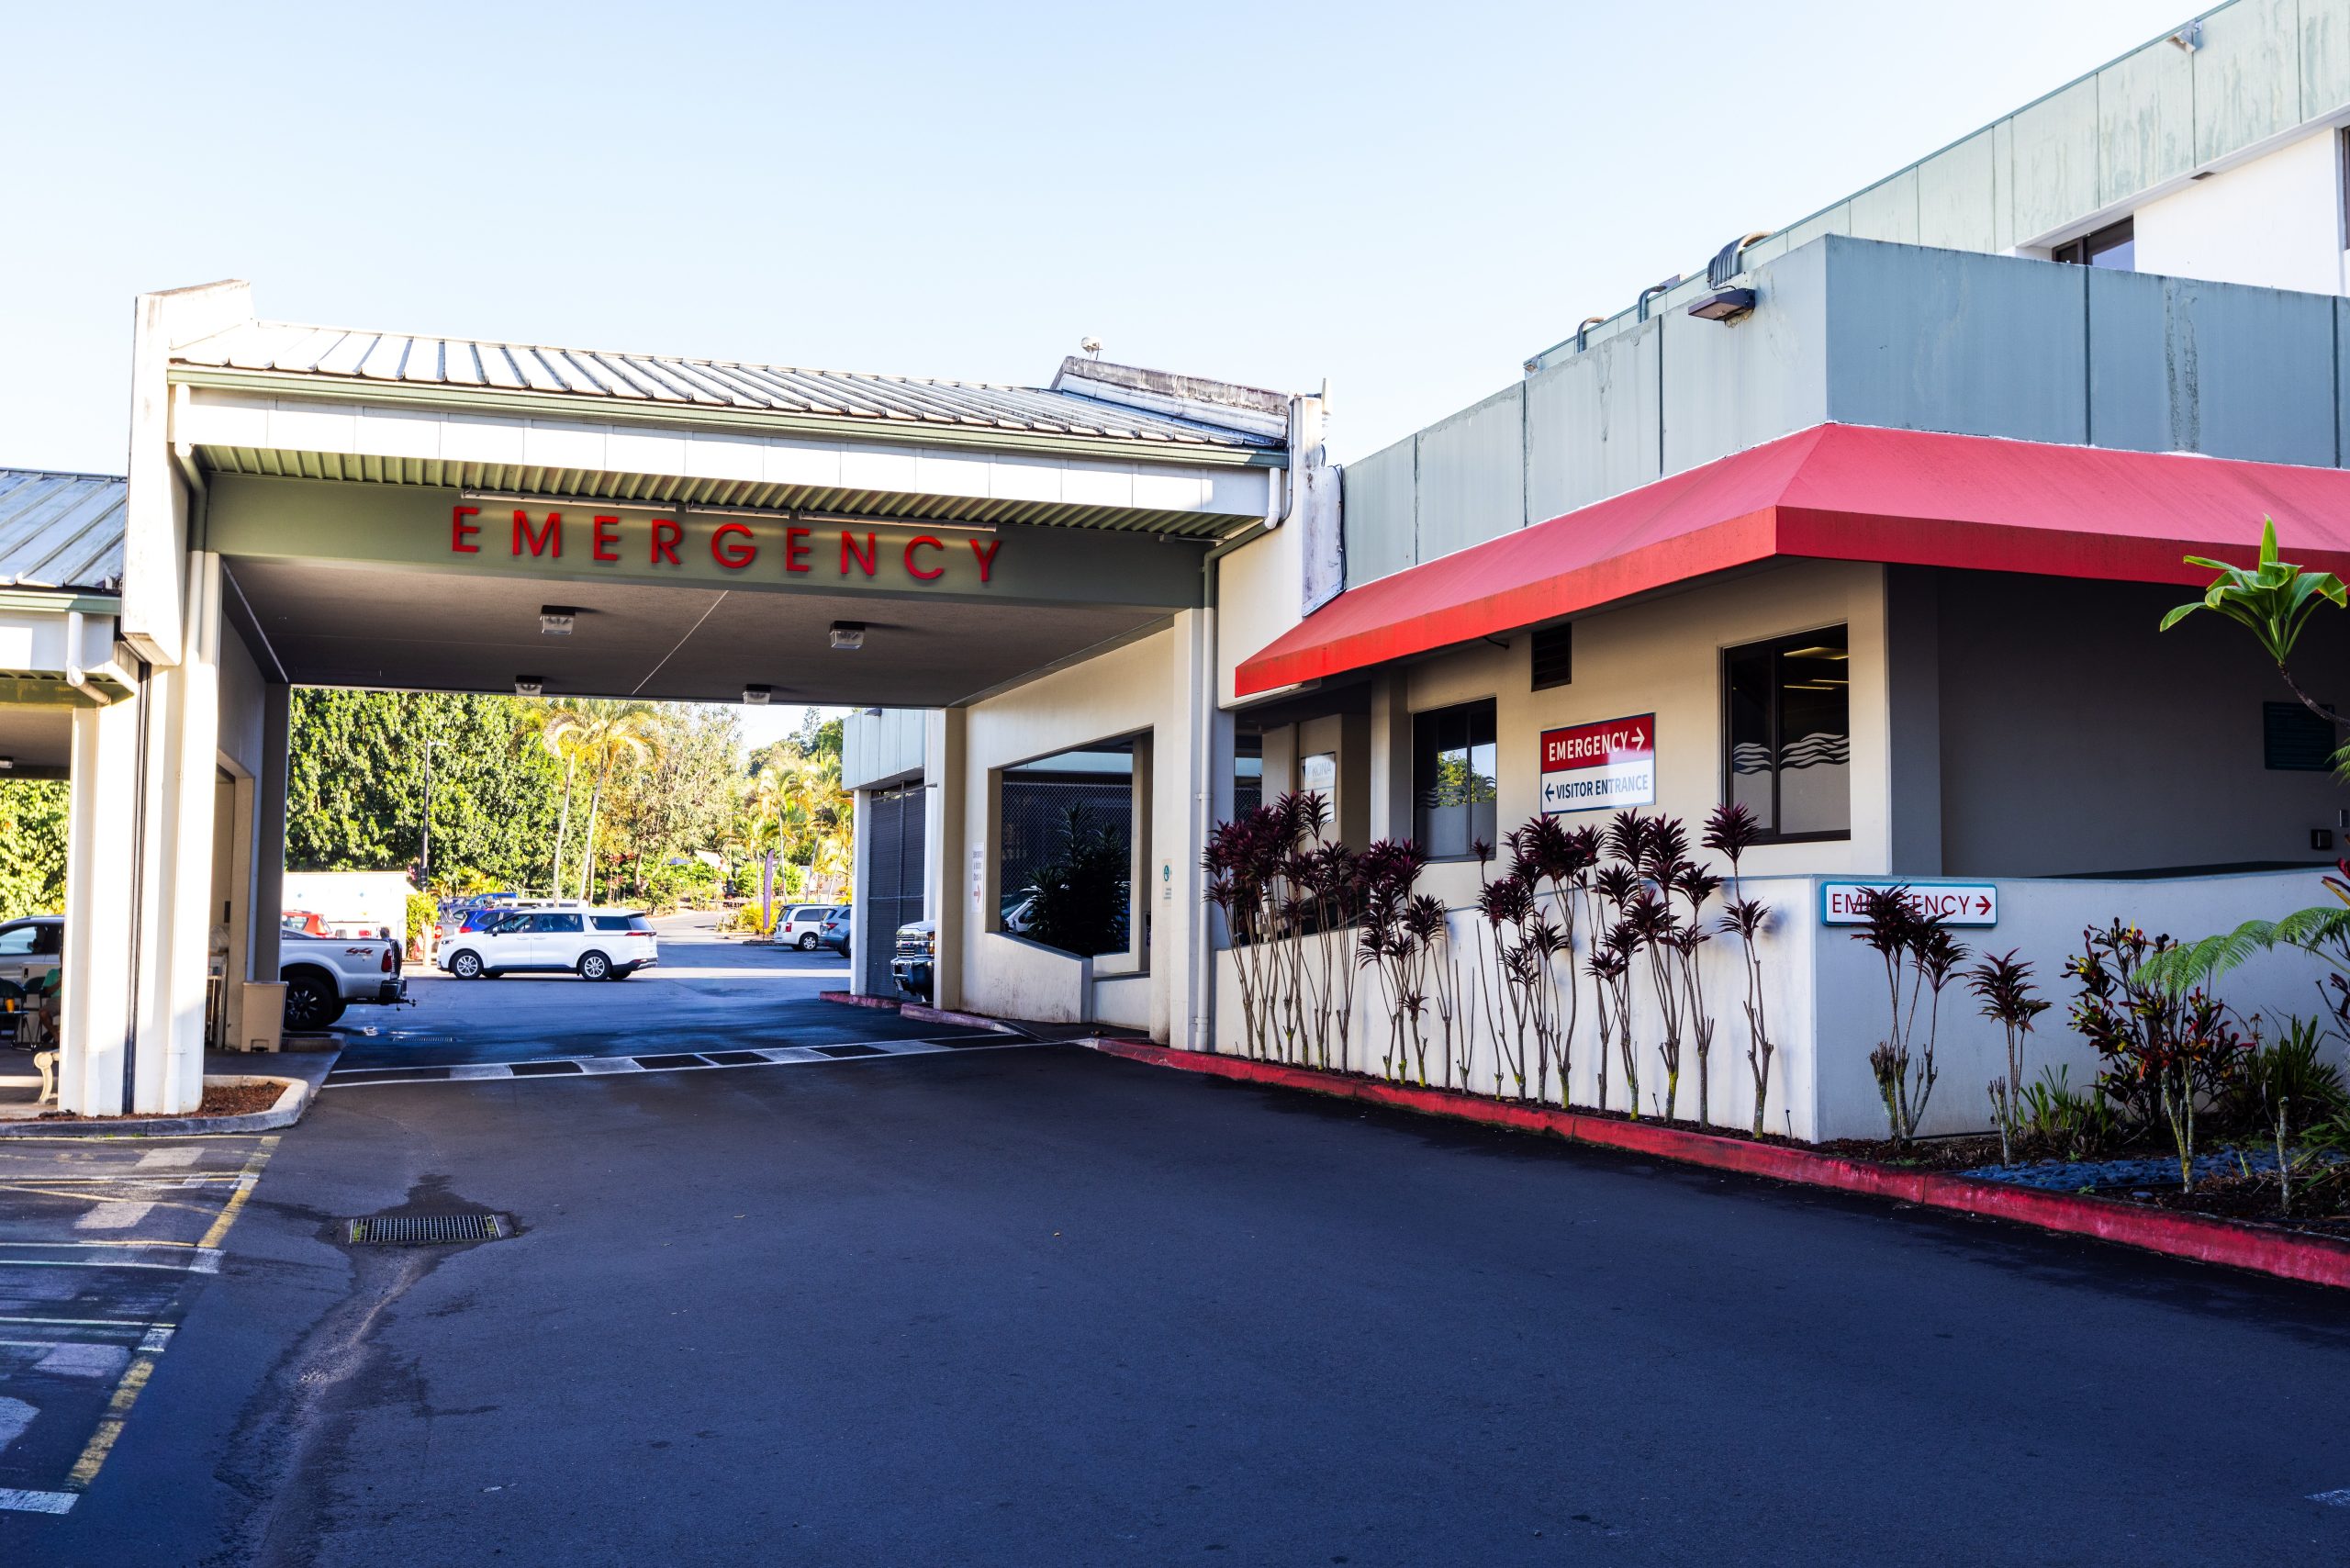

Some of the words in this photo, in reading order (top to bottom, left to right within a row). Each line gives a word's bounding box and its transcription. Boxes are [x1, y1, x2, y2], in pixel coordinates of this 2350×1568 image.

[451, 505, 1002, 583] EMERGENCY
[1549, 731, 1628, 762] EMERGENCY
[1556, 781, 1594, 800] VISITOR
[1595, 774, 1649, 796] ENTRANCE
[1831, 893, 1971, 916] EMENCY
